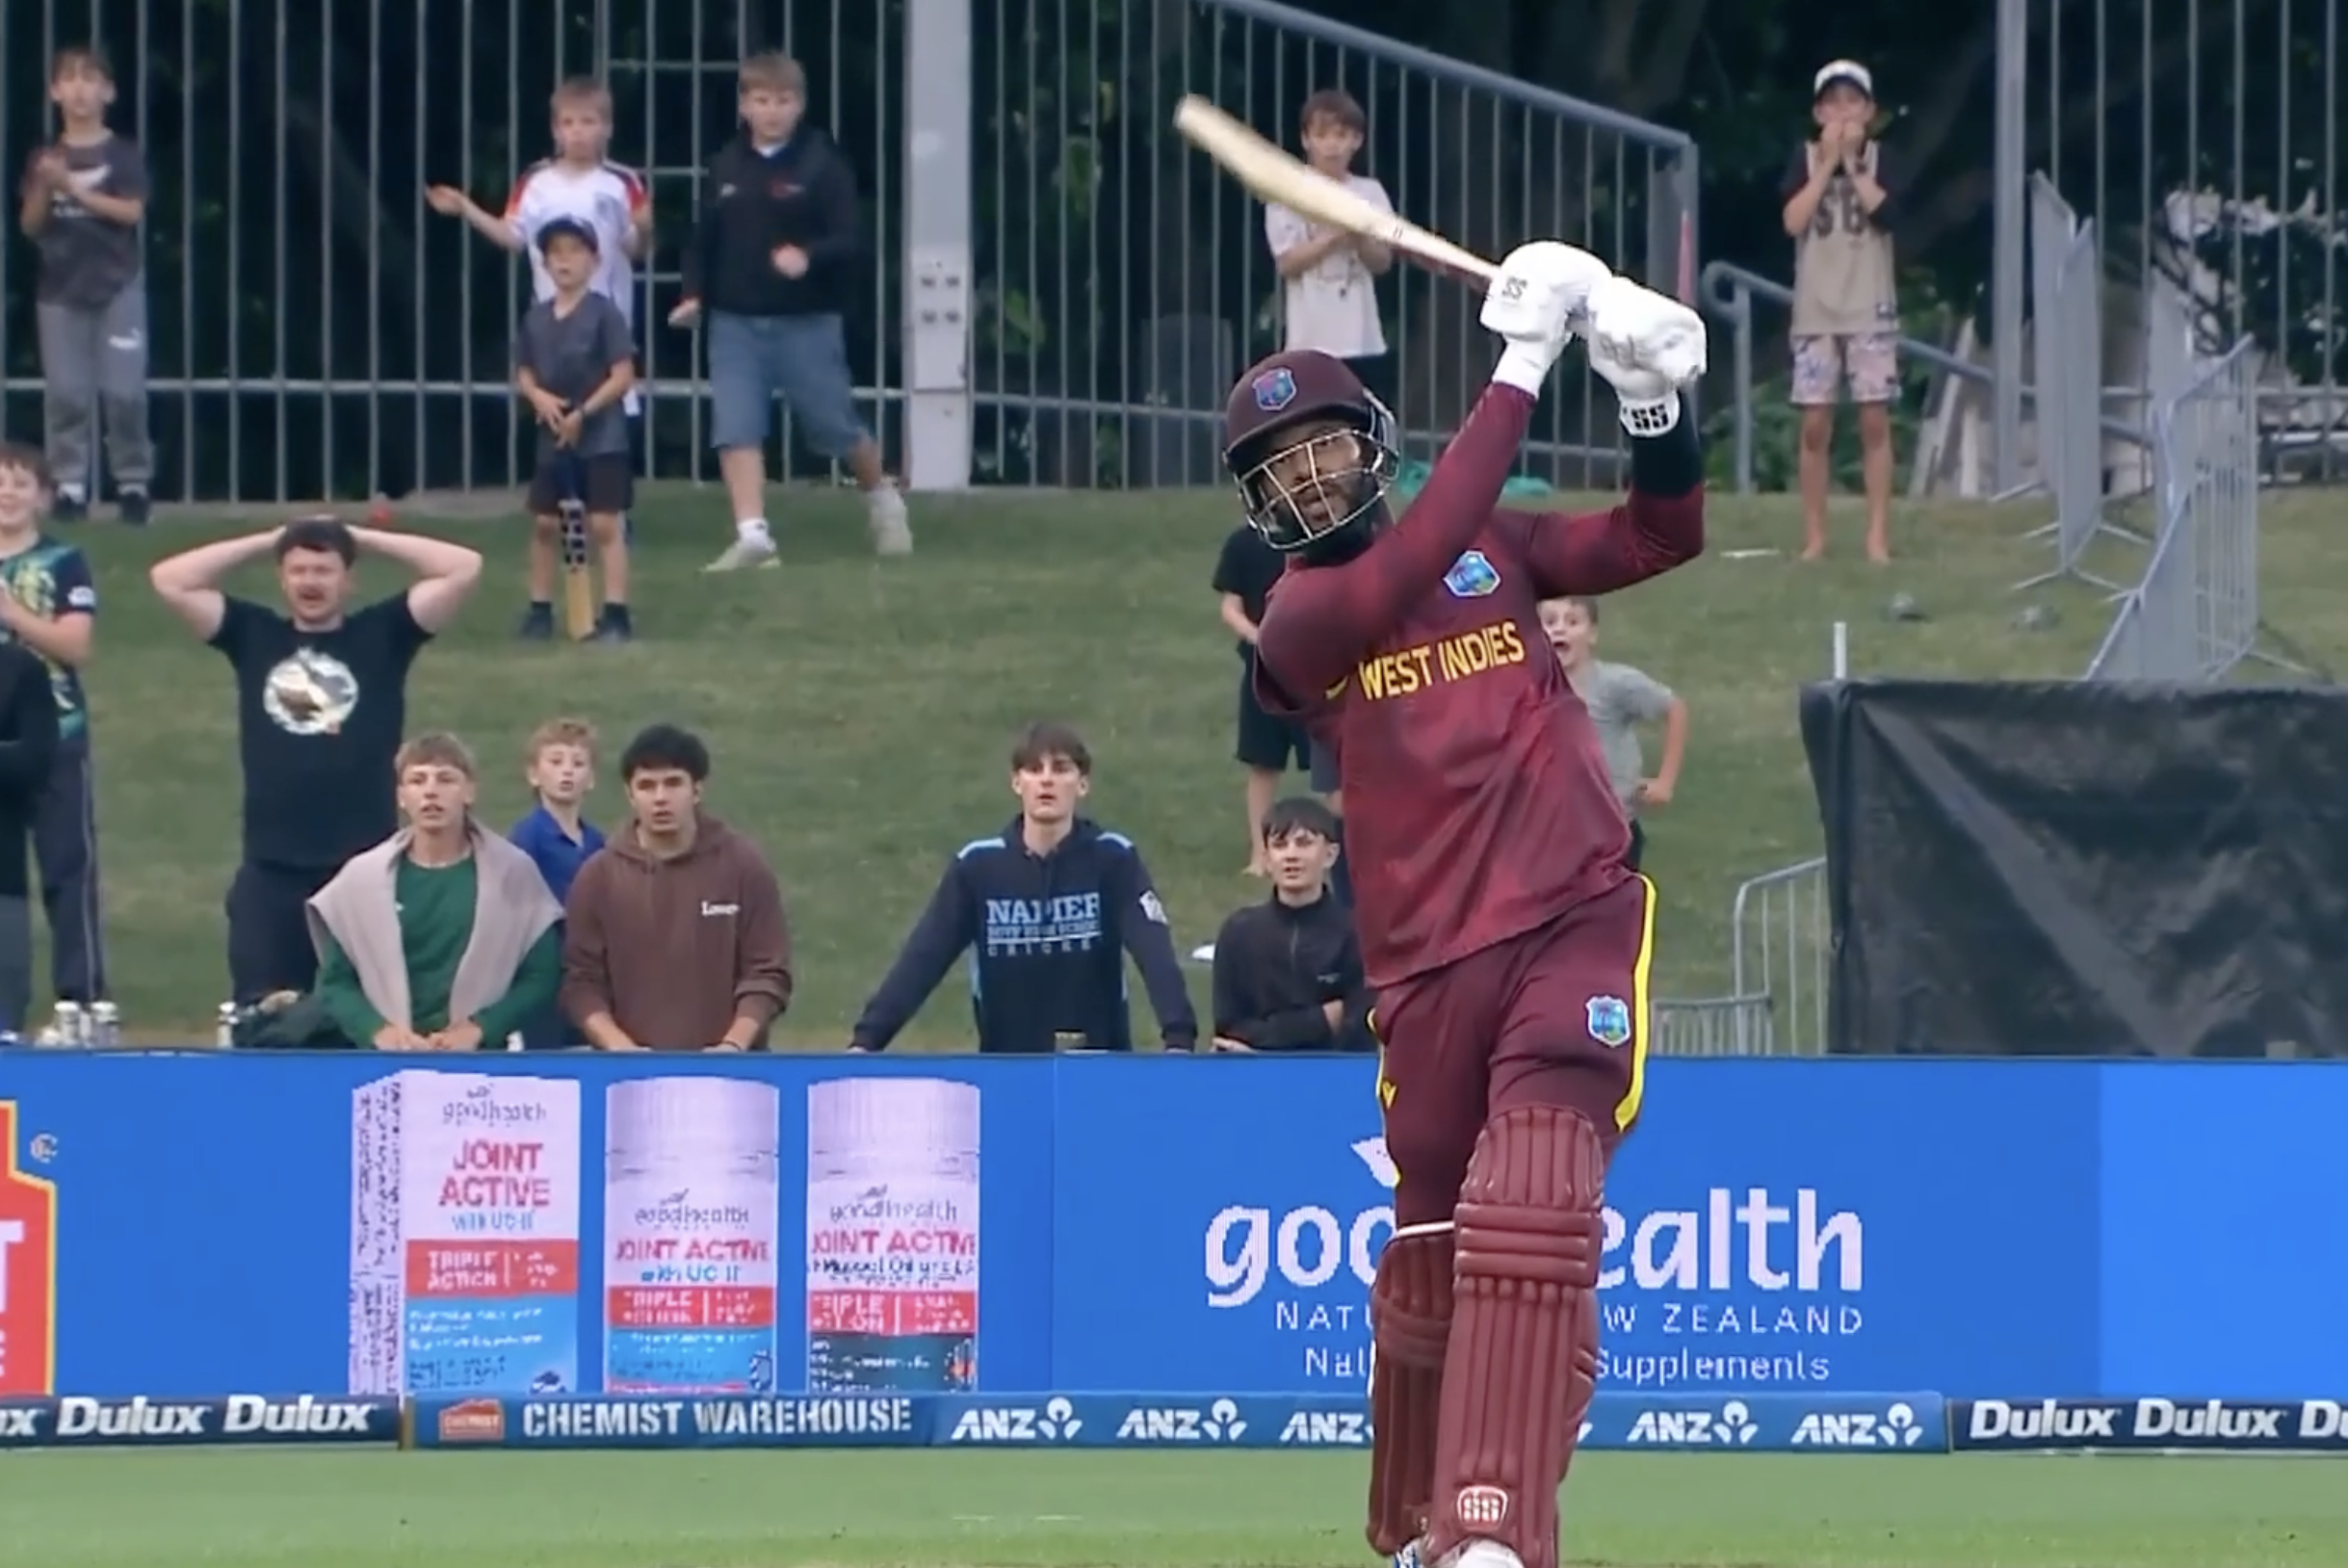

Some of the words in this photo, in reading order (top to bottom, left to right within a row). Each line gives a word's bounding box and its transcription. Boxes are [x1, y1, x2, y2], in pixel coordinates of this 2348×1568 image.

[1358, 644, 1433, 701] WEST
[1437, 621, 1525, 682] INDIES
[454, 1138, 543, 1171] JOINT
[439, 1175, 550, 1207] ACTIVE
[616, 1239, 678, 1261] JOINT
[685, 1238, 770, 1261] ACTIVE
[814, 1230, 879, 1254] JOINT
[1662, 1303, 1863, 1334] ZEALAND
[57, 1396, 204, 1436] Dulux
[223, 1394, 370, 1433] Dulux
[523, 1400, 683, 1437] CHEMIST
[693, 1398, 912, 1434] WAREHOUSE
[951, 1408, 1039, 1441] ANZ
[1116, 1409, 1201, 1441] ANZ
[1280, 1411, 1365, 1443] ANZ
[1627, 1411, 1712, 1443] ANZ
[1791, 1414, 1877, 1445] ANZ
[1970, 1398, 2114, 1438] Dulux
[2134, 1398, 2280, 1437] Dulux
